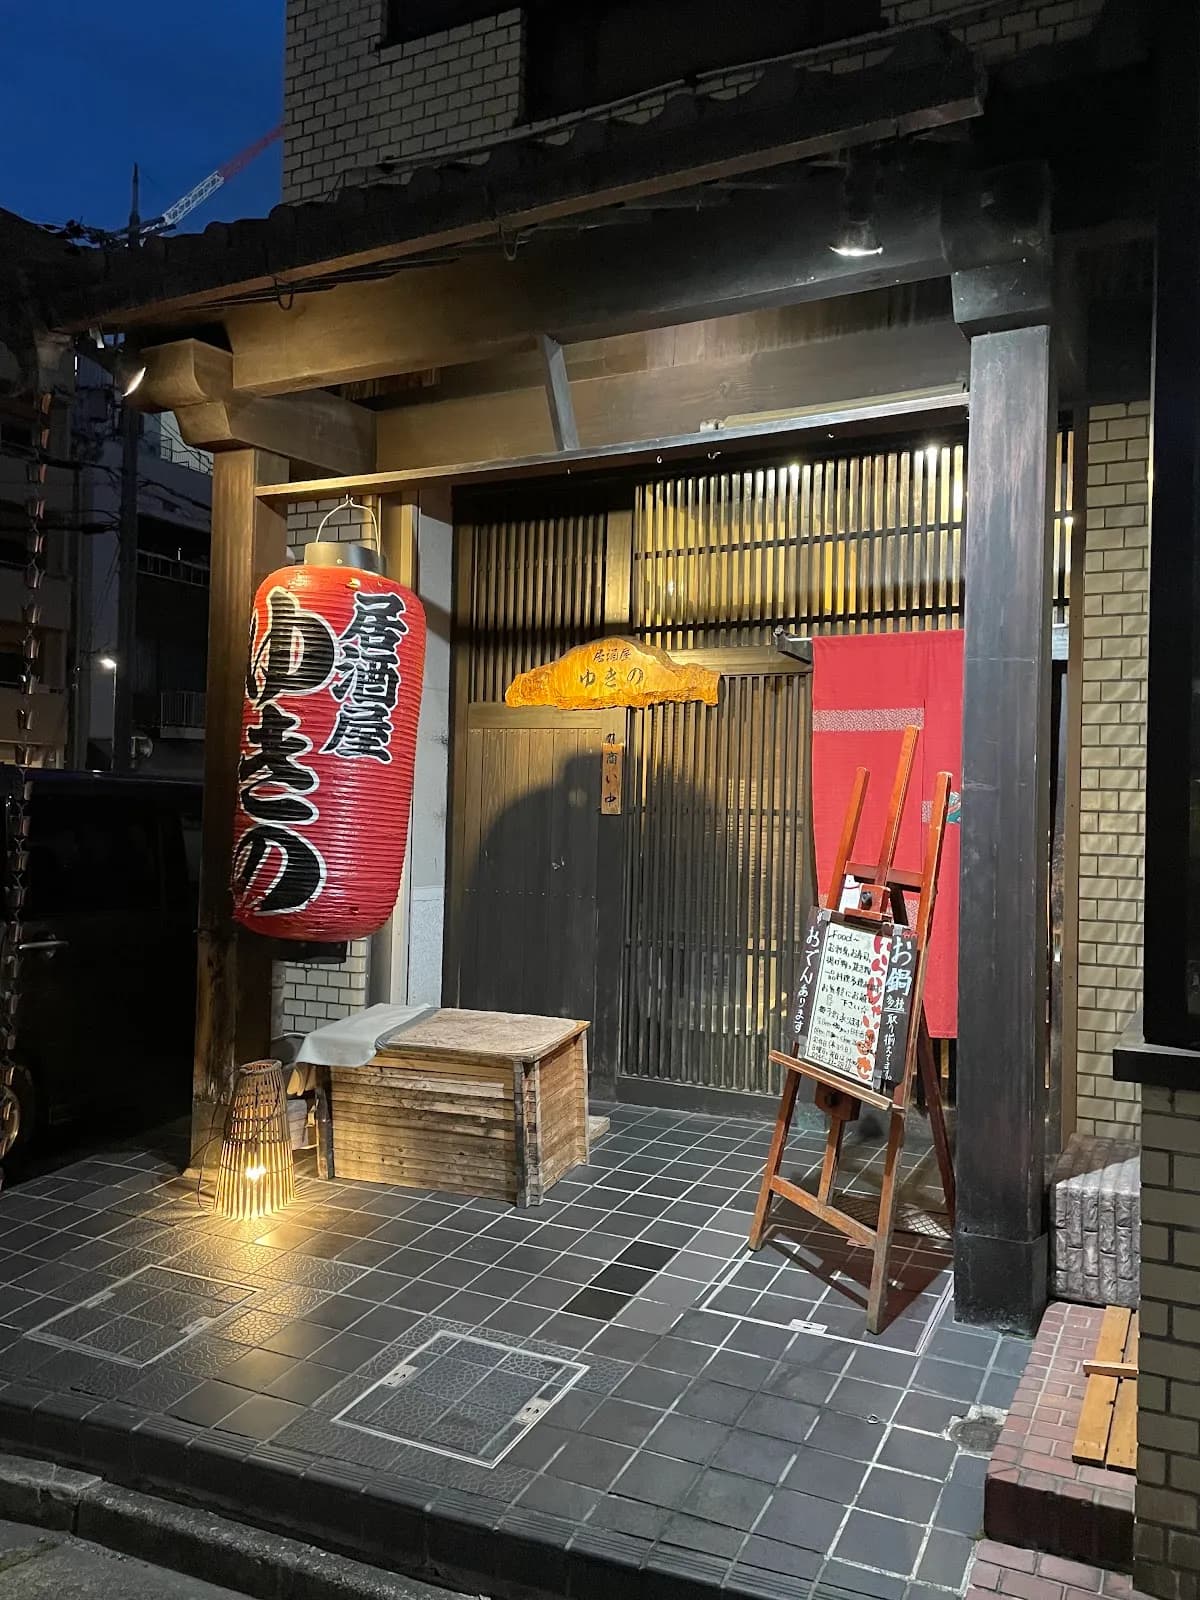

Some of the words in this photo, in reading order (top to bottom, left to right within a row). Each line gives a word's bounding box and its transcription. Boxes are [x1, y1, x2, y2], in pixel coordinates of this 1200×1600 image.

[319, 590, 410, 764] 居酒屋
[579, 667, 645, 688] ゆきの
[593, 647, 632, 663] 居酒屋
[234, 586, 327, 917] ゆきの
[604, 751, 618, 808] 商い中
[794, 927, 820, 1034] おでんあります
[885, 936, 913, 996] お鍋
